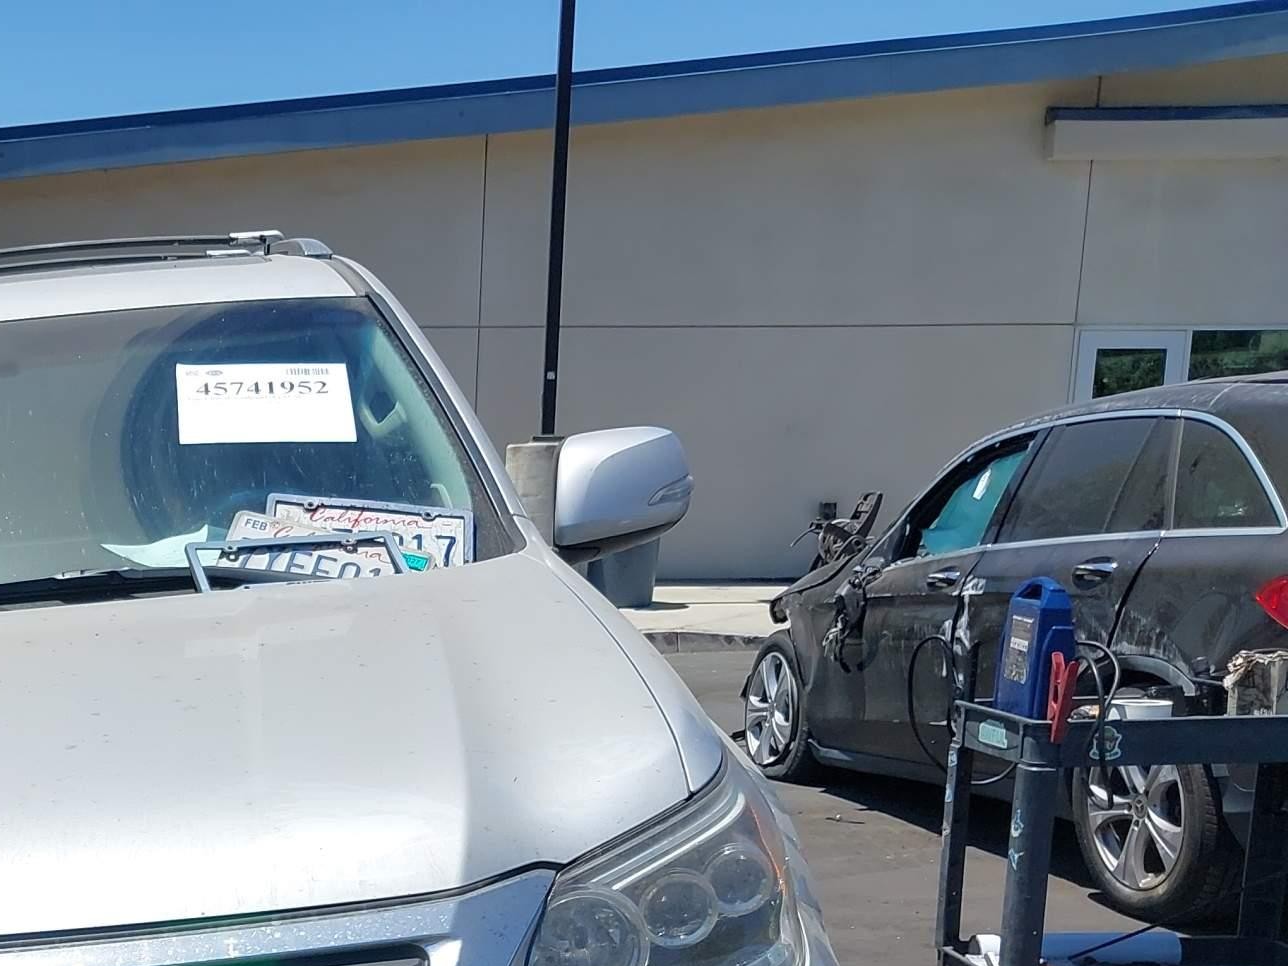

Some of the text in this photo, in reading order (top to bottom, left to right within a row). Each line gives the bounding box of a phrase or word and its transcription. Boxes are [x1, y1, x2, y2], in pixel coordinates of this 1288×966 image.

[196, 380, 329, 396] 45741952
[243, 518, 268, 532] FEB
[309, 507, 426, 529] California
